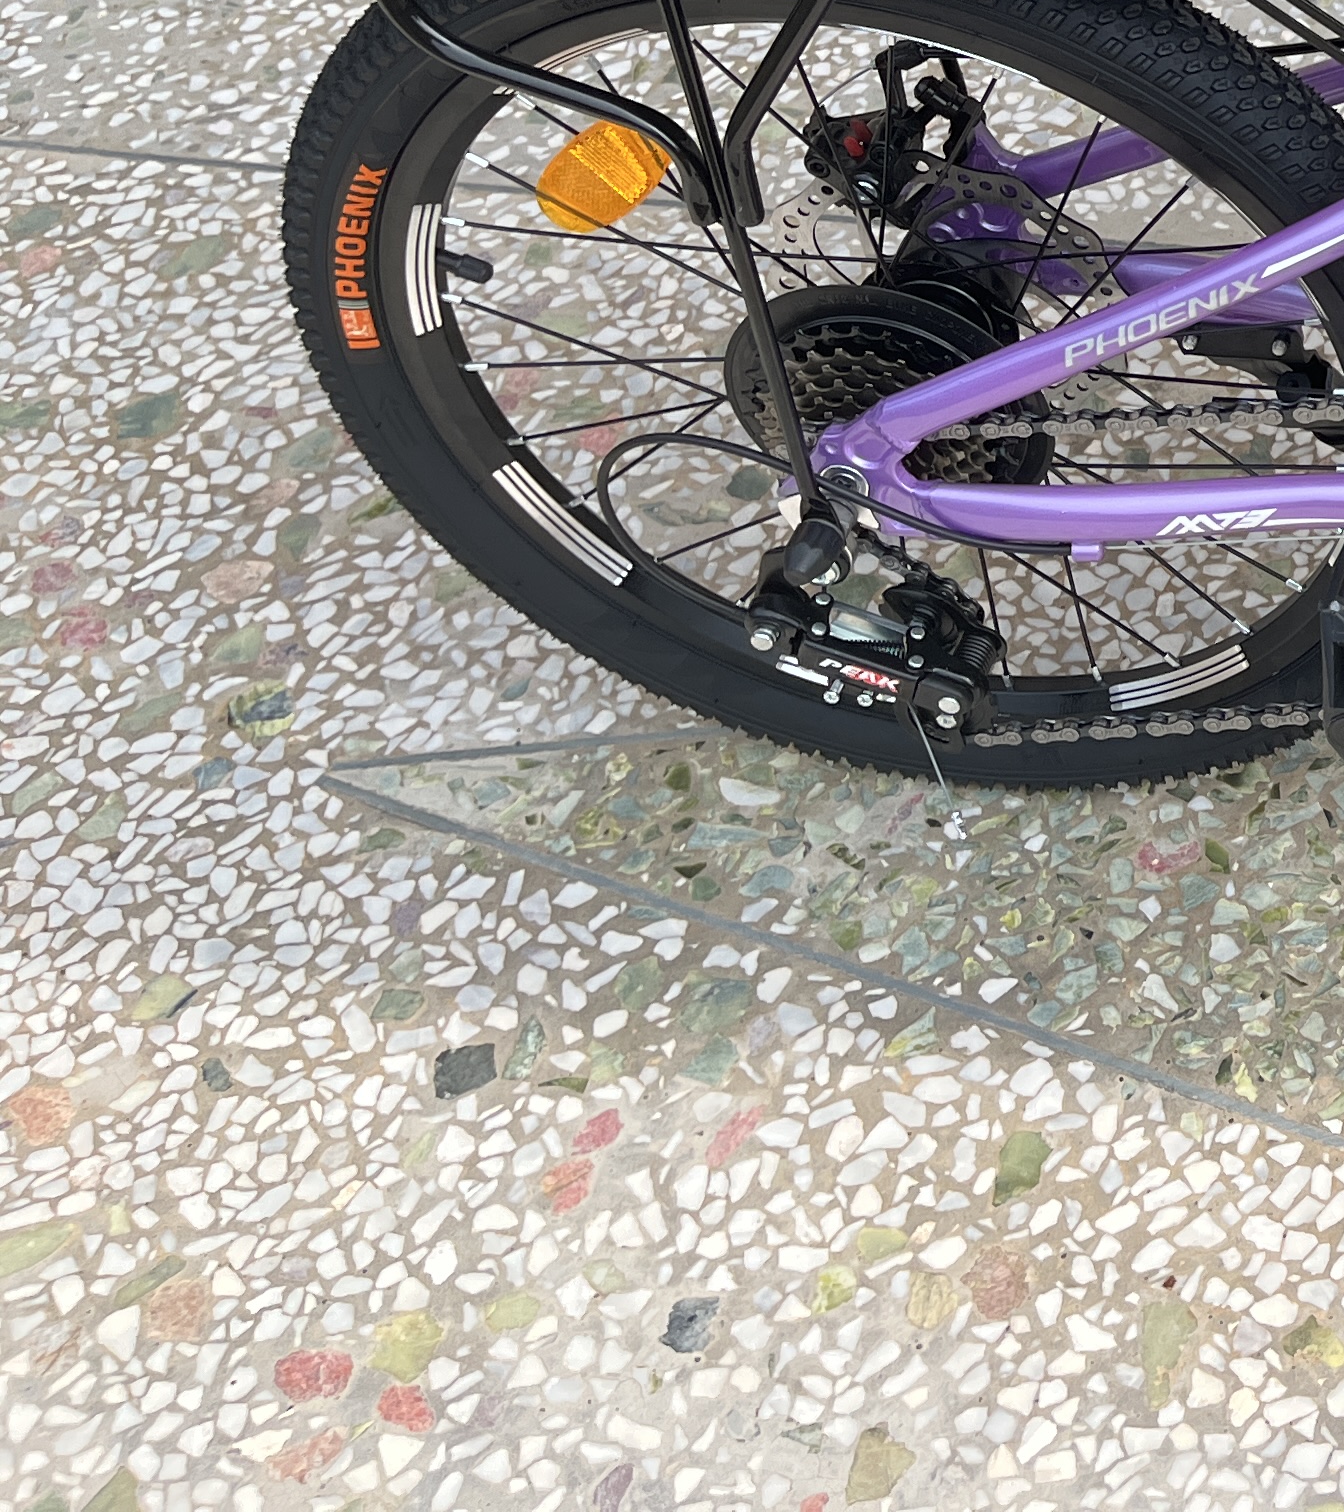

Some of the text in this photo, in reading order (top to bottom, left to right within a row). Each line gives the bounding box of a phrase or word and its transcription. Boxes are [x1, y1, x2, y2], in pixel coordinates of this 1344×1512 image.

[335, 164, 388, 299] PHOENIX
[1064, 272, 1260, 368] PHOENIX
[819, 658, 899, 693] PEAK
